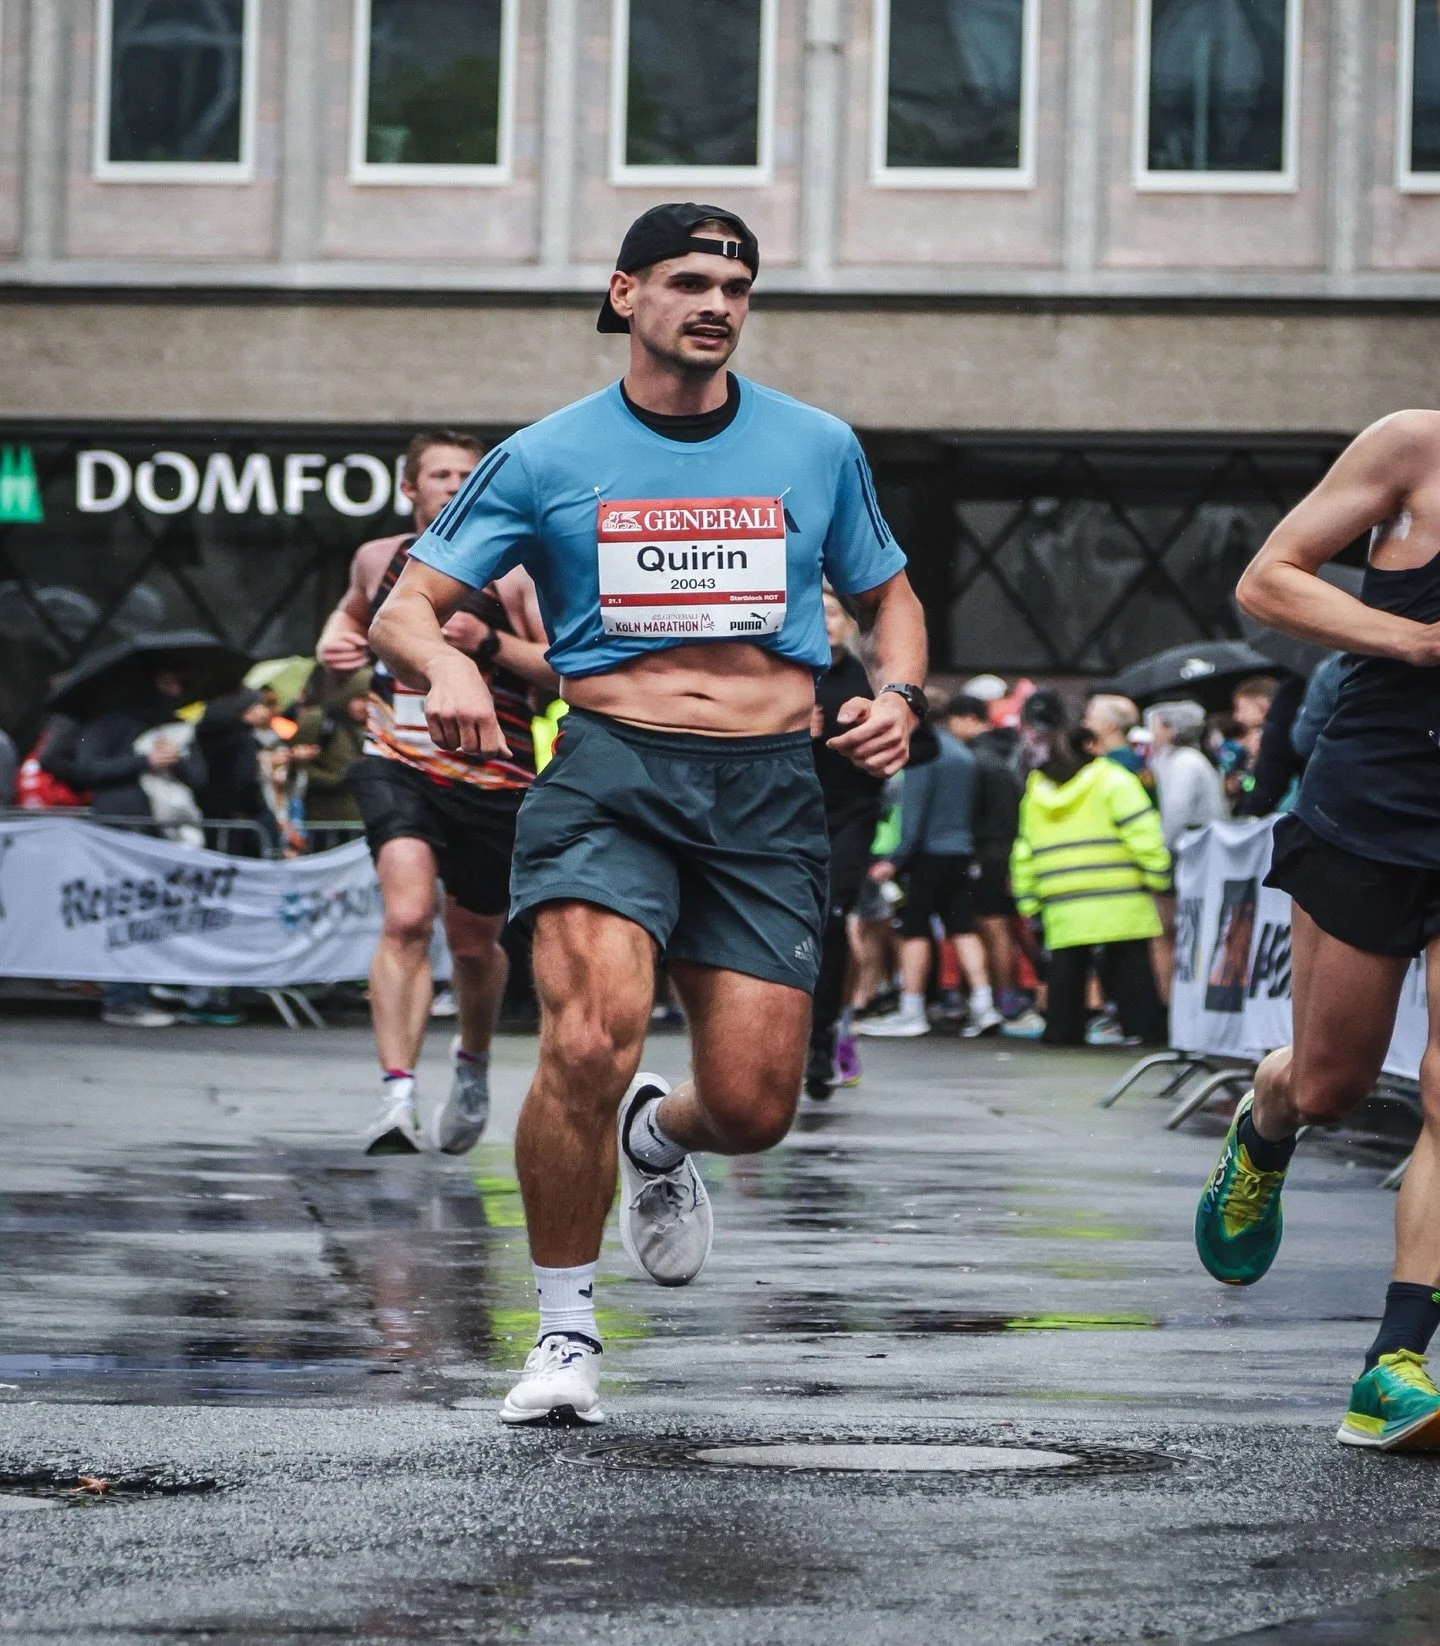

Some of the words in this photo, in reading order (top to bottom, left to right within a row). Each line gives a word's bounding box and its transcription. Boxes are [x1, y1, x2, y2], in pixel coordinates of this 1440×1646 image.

[644, 508, 777, 531] GENERALI
[637, 544, 748, 573] Quirin
[670, 578, 716, 590] 20043
[643, 620, 699, 632] MARATHON
[730, 621, 762, 631] PUMA
